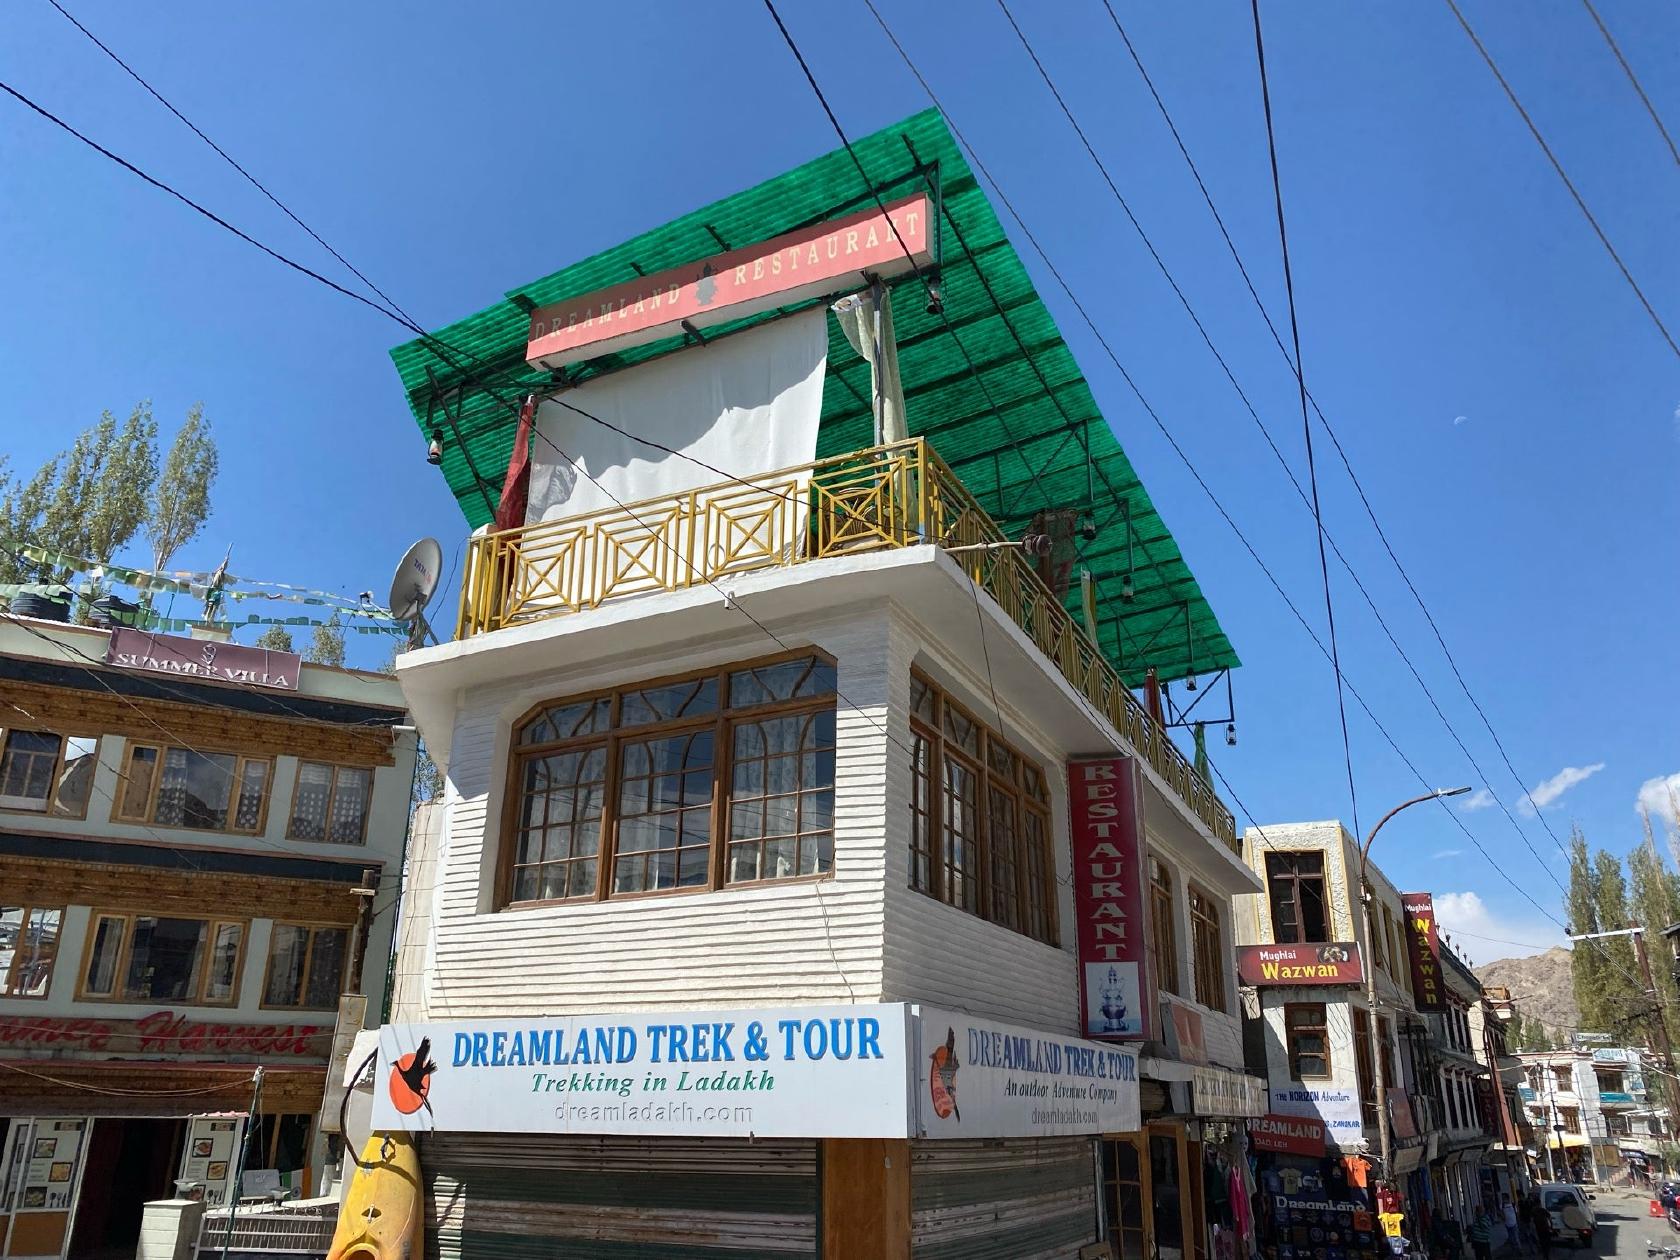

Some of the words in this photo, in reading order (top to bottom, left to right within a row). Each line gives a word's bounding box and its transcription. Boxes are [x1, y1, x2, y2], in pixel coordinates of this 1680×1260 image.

[535, 283, 681, 340] DREAMLAND
[733, 211, 919, 286] RESTAURANT
[116, 653, 218, 676] SUMMER
[224, 667, 288, 687] VILLA
[1083, 765, 1128, 960] RESTAURANT
[1404, 903, 1432, 914] Mughlai
[1259, 949, 1297, 962] Mughlai
[1411, 918, 1437, 1004] Wazwan
[1261, 963, 1339, 981] Wazwan
[136, 1011, 319, 1054] Harvest
[452, 1025, 638, 1068] DREAMLAND
[647, 1022, 736, 1064] TREK
[743, 1020, 770, 1062] &
[778, 1017, 884, 1061] TOUR
[967, 1028, 1062, 1075] DREAMLAND
[1064, 1045, 1096, 1077] TREK
[1097, 1051, 1106, 1078] &
[1107, 1052, 1136, 1082] TOUR
[531, 1072, 635, 1098] Trekking
[643, 1071, 668, 1091] in
[676, 1070, 776, 1092] Ladakh
[1004, 1077, 1017, 1097] An
[1019, 1079, 1048, 1097] outdoor
[1052, 1080, 1087, 1099] Adventure
[1089, 1083, 1118, 1104] Company
[1289, 1090, 1319, 1102] HORIZON
[554, 1101, 754, 1123] dreamladakh.com
[1031, 1107, 1098, 1125] dreamladakh.com
